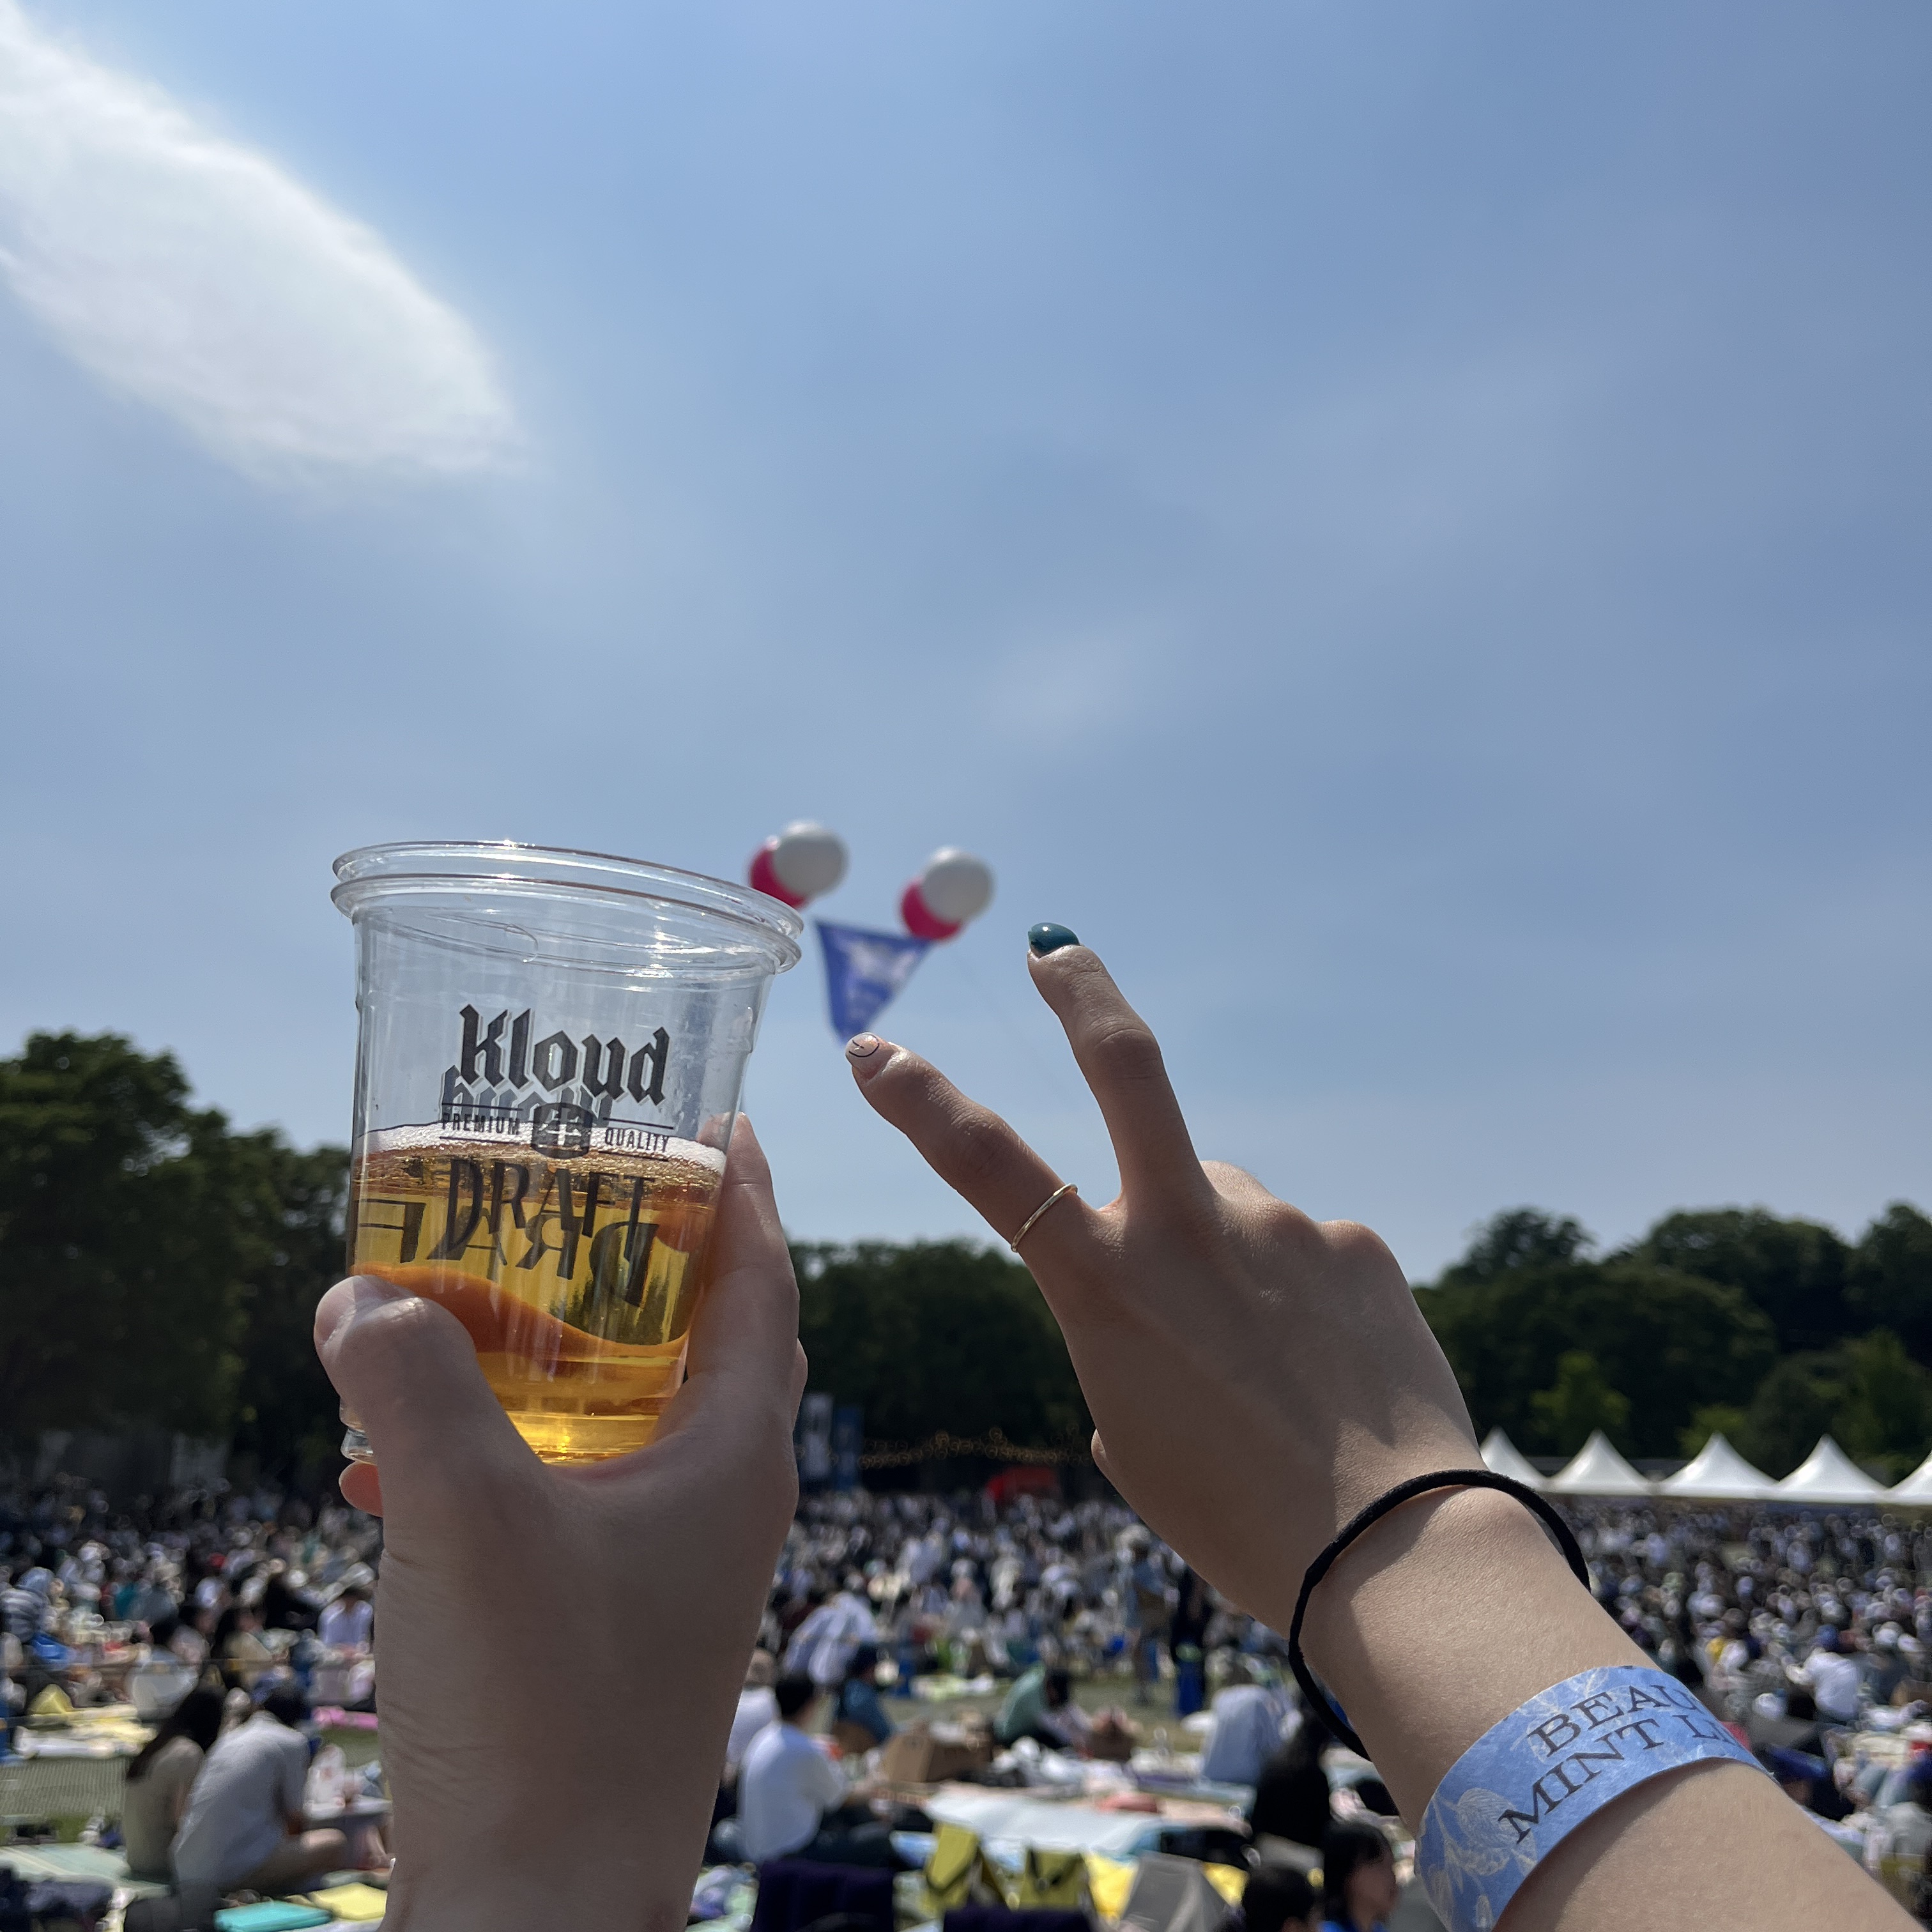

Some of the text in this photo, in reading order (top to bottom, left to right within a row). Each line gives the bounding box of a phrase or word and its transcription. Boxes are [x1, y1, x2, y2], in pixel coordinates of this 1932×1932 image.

[459, 1004, 670, 1106] Kloud
[441, 1112, 671, 1153] PREMIUM QUALITY
[447, 1159, 655, 1262] DRAFT
[1498, 1719, 1665, 1844] MINT
